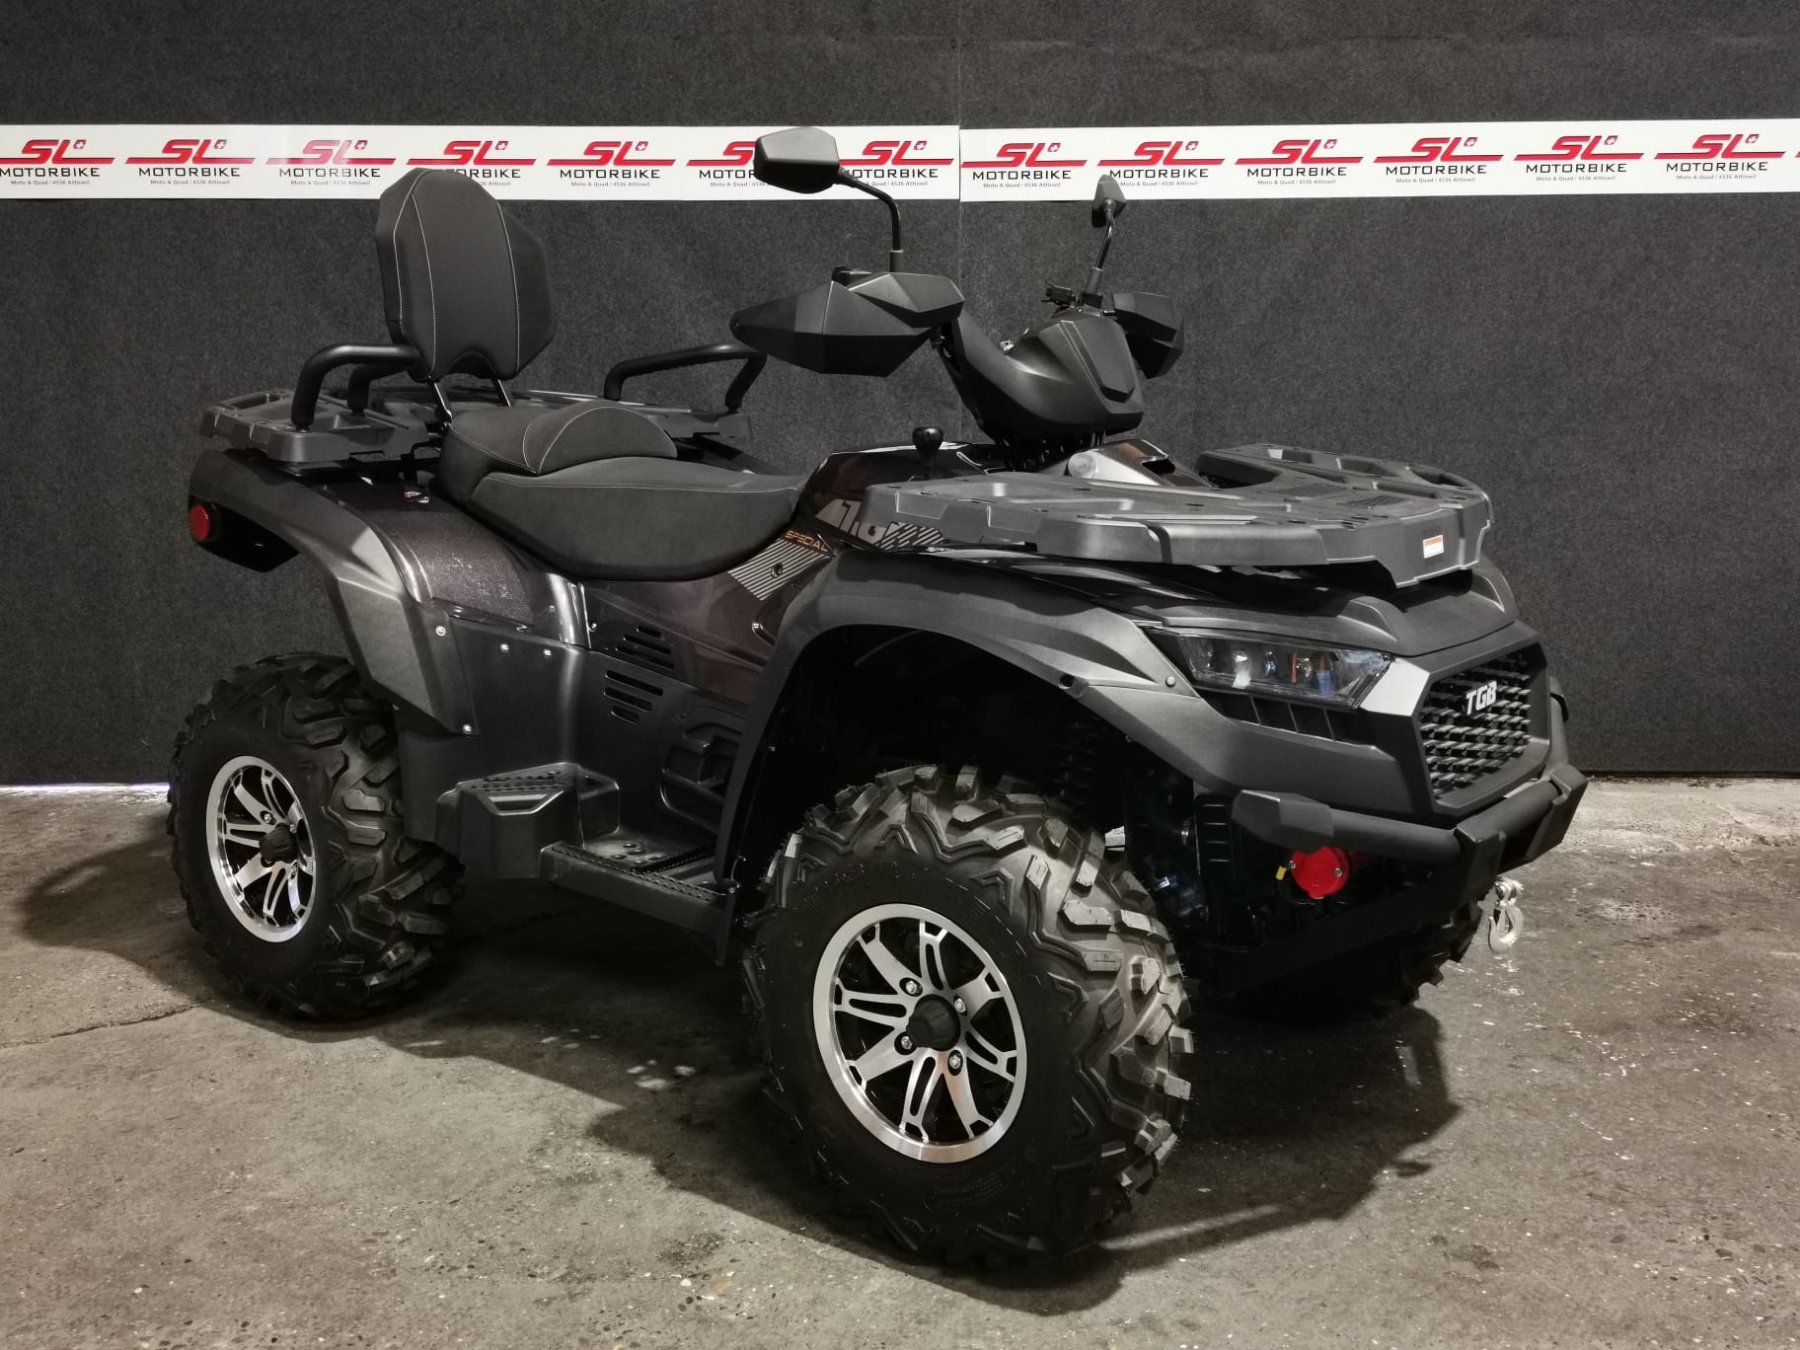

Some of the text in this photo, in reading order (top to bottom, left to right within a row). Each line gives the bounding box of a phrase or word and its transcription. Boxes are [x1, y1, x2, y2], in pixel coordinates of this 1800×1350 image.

[1385, 165, 1486, 175] MOTORBIKE
[1525, 164, 1627, 173] MOTORBIKE
[1666, 162, 1768, 171] MOTORBIKE
[0, 168, 100, 177] MOTORBIKE
[139, 168, 240, 177] MOTORBIKE
[279, 169, 381, 177] MOTORBIKE
[560, 169, 660, 178] MOTORBIKE
[851, 169, 938, 179] OTORBIKE
[972, 170, 1071, 179] MOTORBIKE
[1109, 169, 1208, 178] MOTORBIKE
[1247, 168, 1347, 177] MOTORBIKE
[784, 530, 828, 552] SPECIAL
[1466, 680, 1497, 716] TGB
